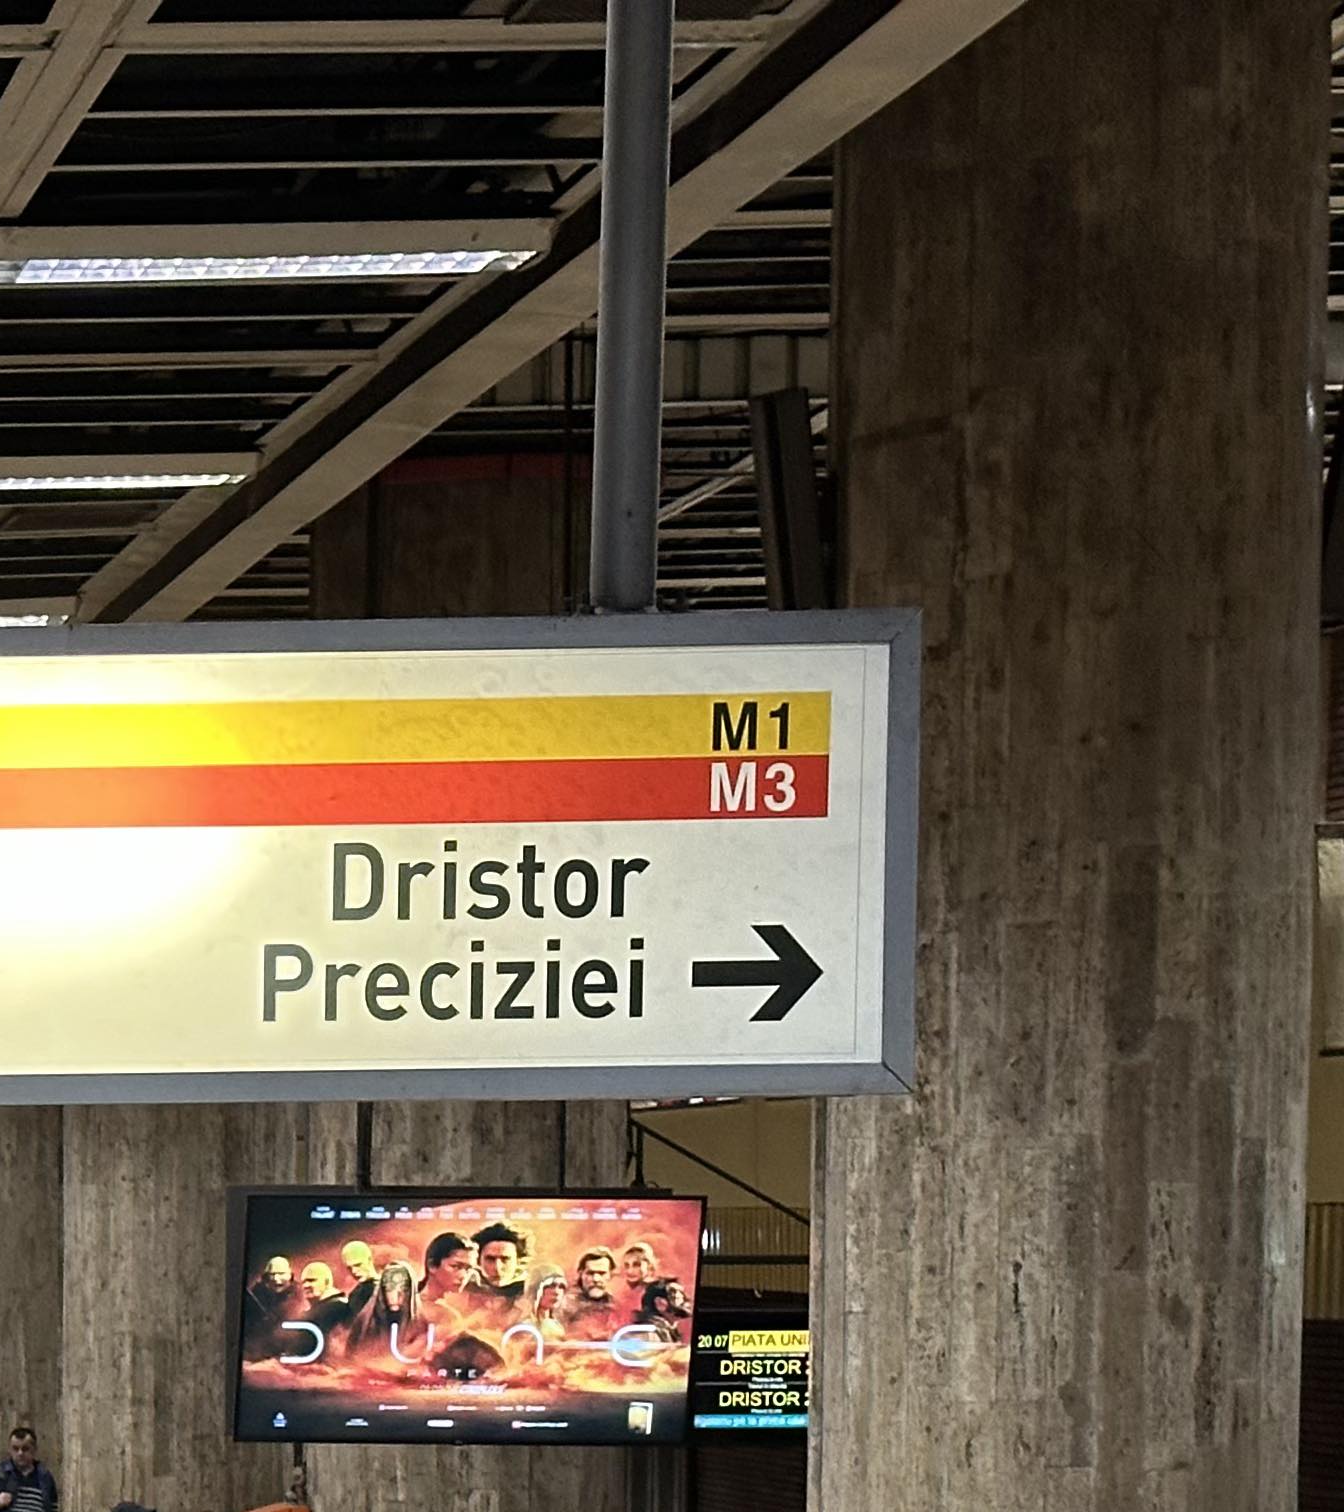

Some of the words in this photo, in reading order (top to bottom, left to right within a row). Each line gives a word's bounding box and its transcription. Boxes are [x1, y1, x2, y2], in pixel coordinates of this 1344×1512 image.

[712, 701, 791, 751] M1
[710, 762, 796, 812] M3
[332, 840, 651, 921] Dristor
[262, 937, 646, 1022] Preciziei
[281, 1321, 657, 1367] DUNE
[731, 1334, 777, 1347] PIATA
[780, 1334, 809, 1347] UNI
[720, 1359, 802, 1375] DRISTOR
[718, 1391, 801, 1407] DRISTOR
